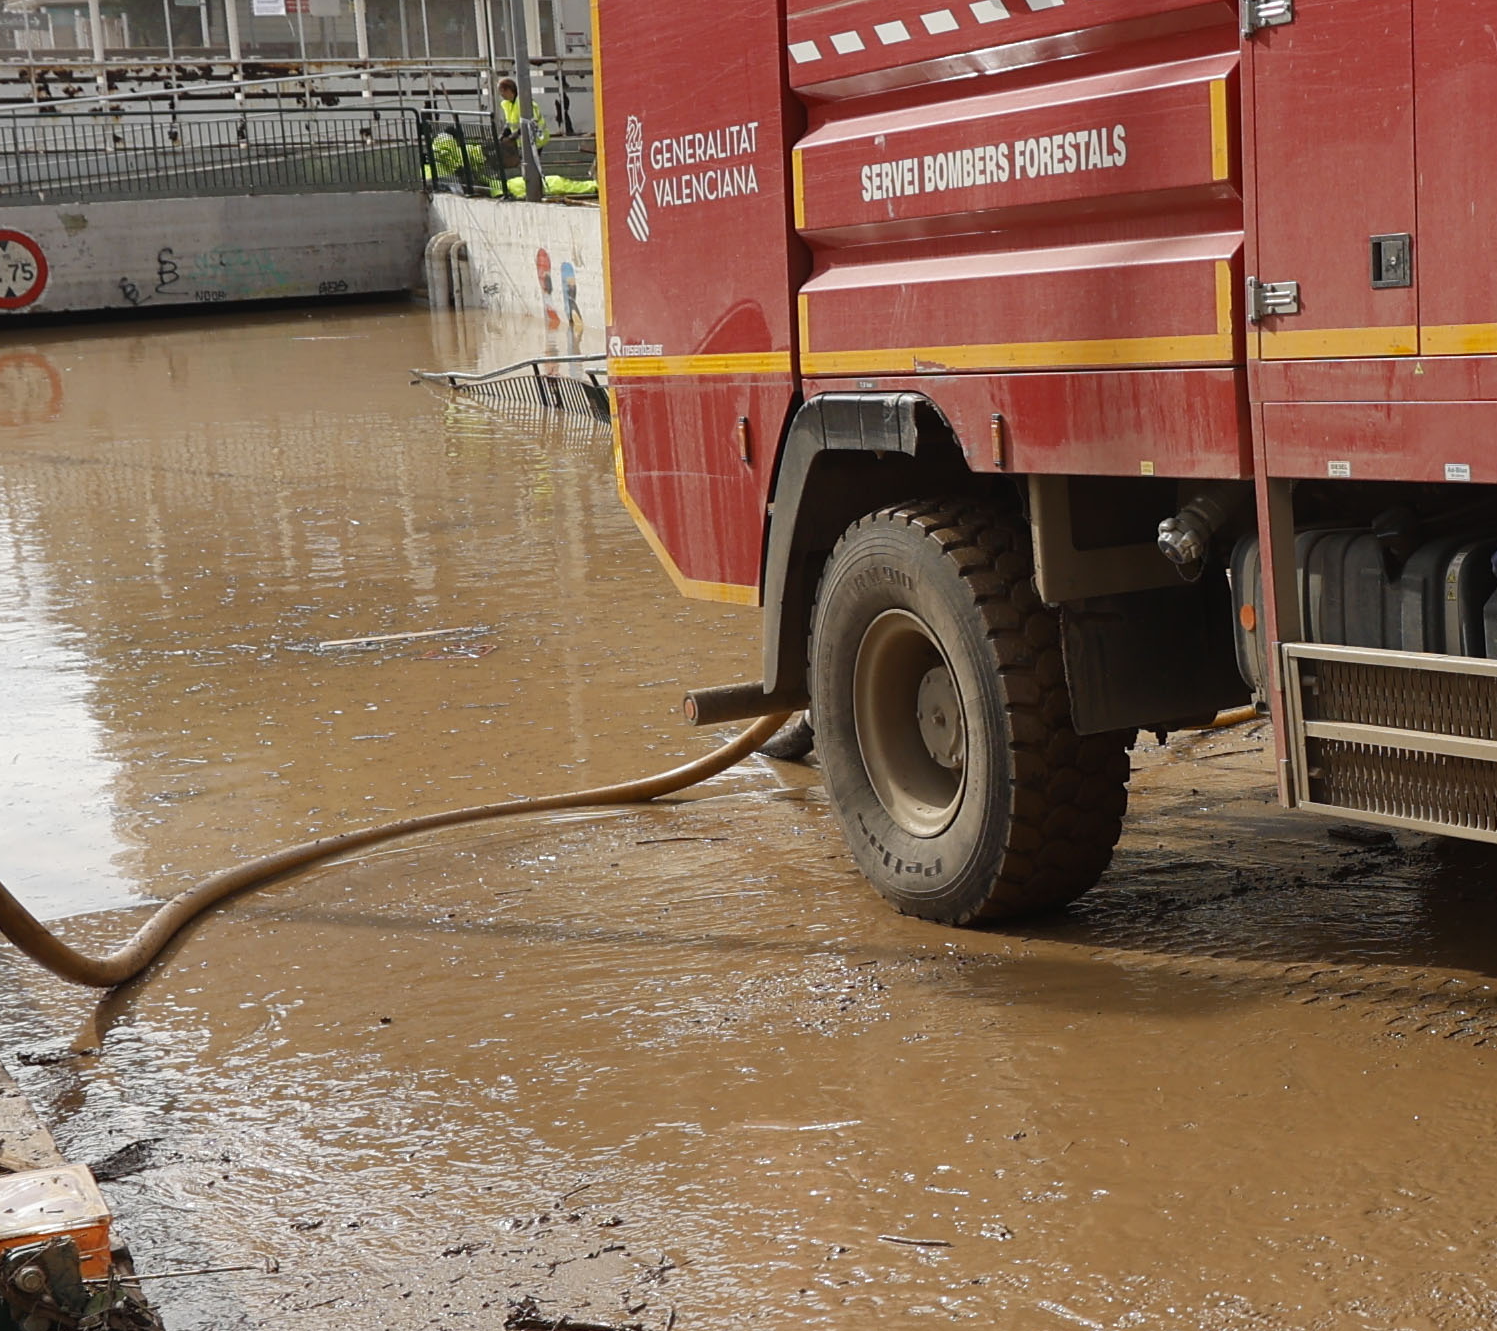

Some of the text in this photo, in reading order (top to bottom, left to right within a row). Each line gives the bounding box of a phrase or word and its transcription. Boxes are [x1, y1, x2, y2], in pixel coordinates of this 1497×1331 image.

[649, 121, 758, 171] GENERALITAT
[861, 124, 1127, 202] SERVEI BOMBERS FORESTALS
[652, 164, 758, 208] VALENCIANA
[8, 263, 34, 282] 75
